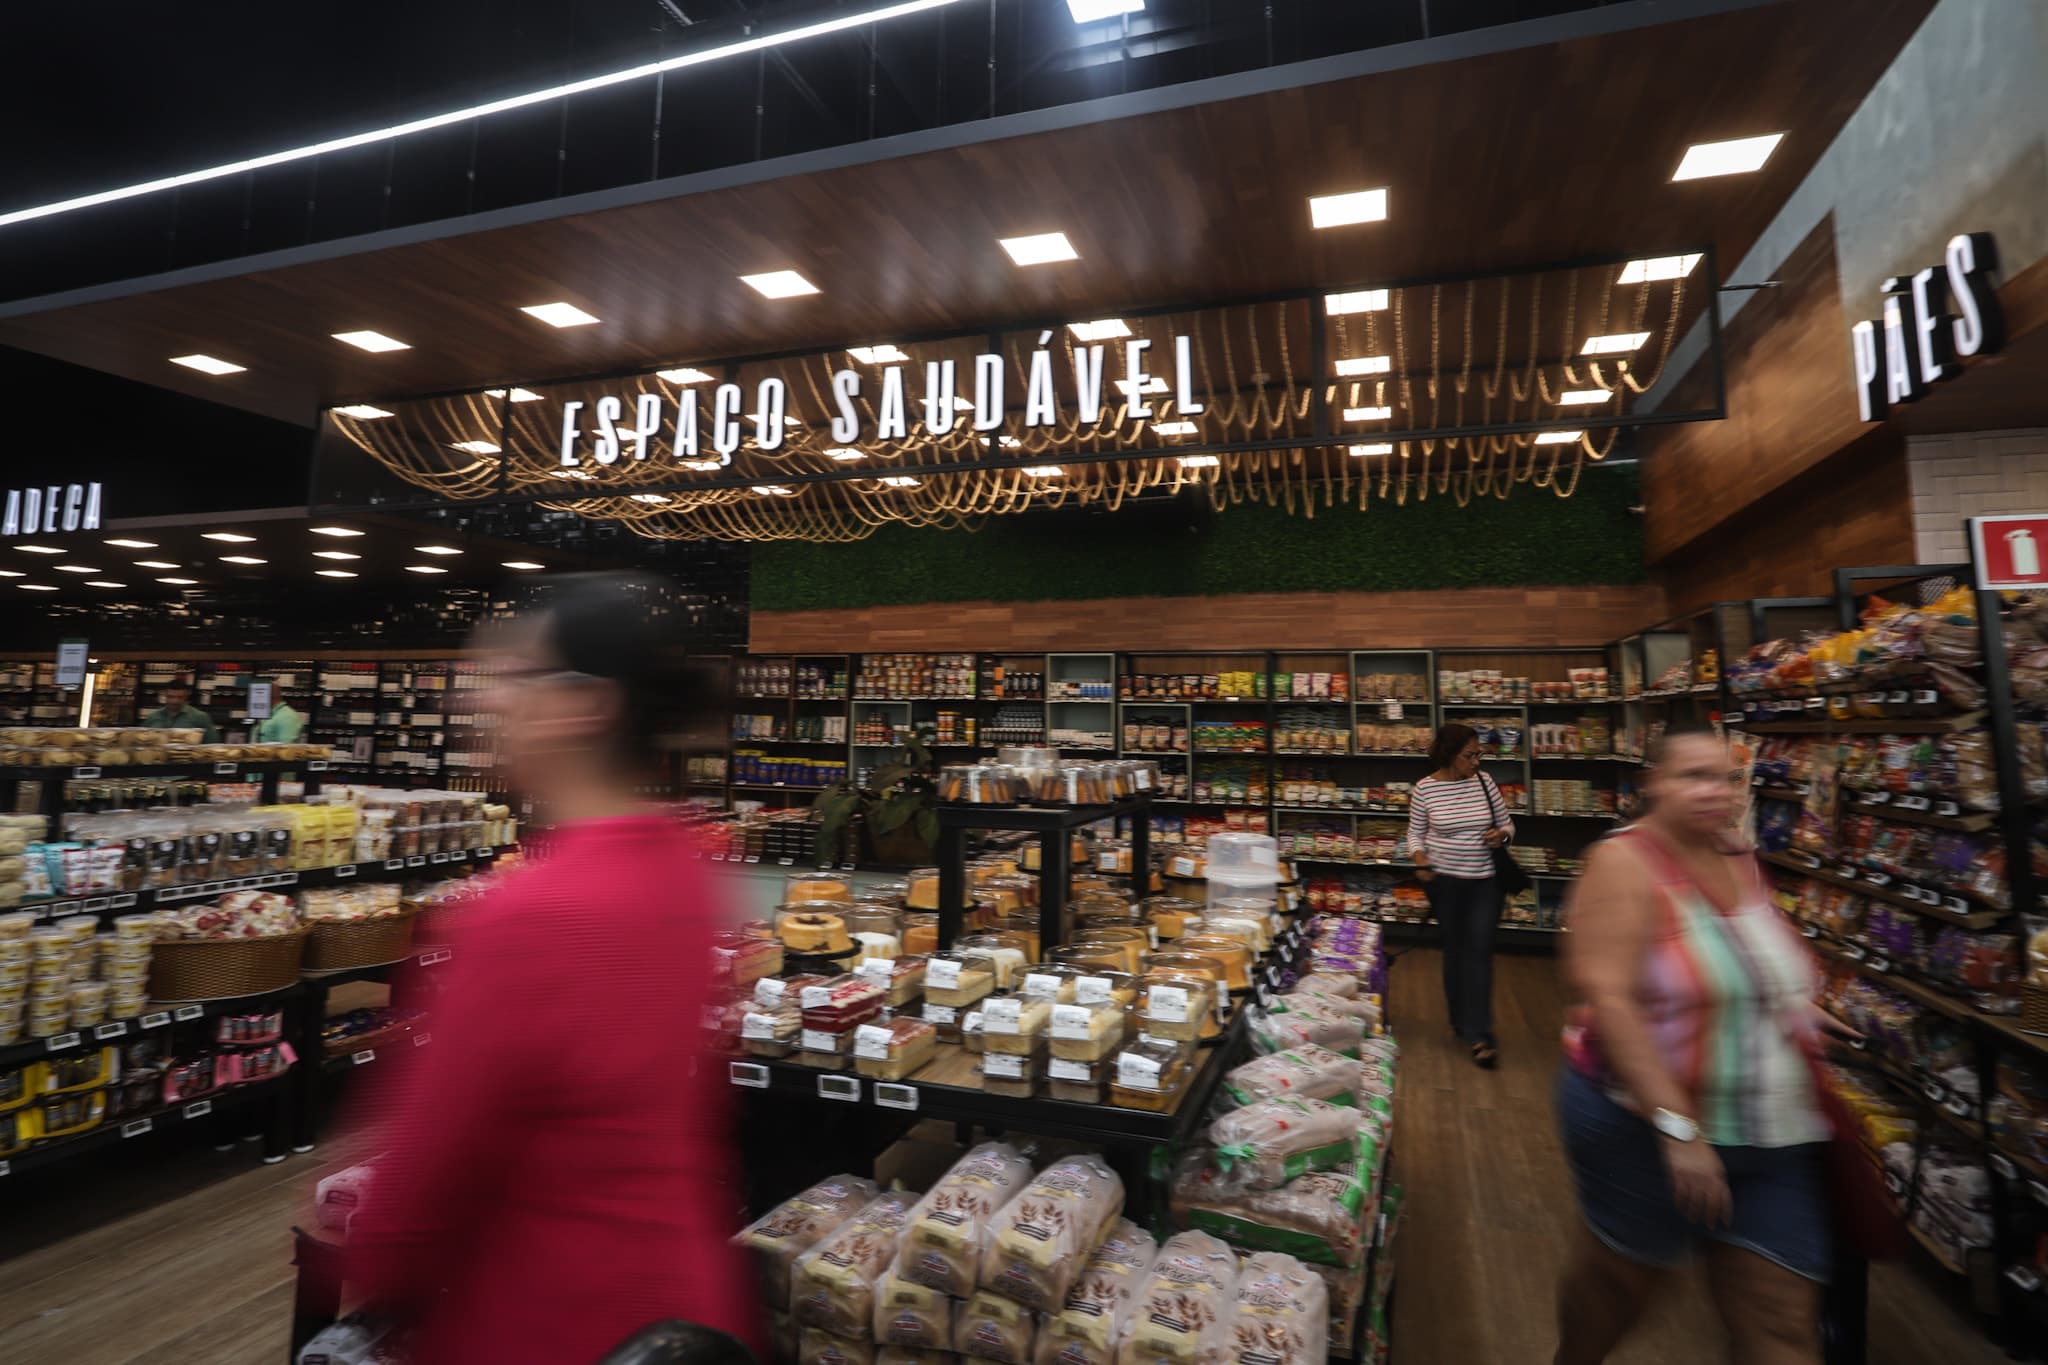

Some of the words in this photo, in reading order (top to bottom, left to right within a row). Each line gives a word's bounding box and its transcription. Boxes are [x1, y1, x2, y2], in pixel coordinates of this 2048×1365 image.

[1852, 233, 1984, 422] PÃES
[560, 376, 785, 467] ESPAÇO
[831, 330, 1204, 445] SAUDÁVEL
[1, 481, 102, 536] ADEGA
